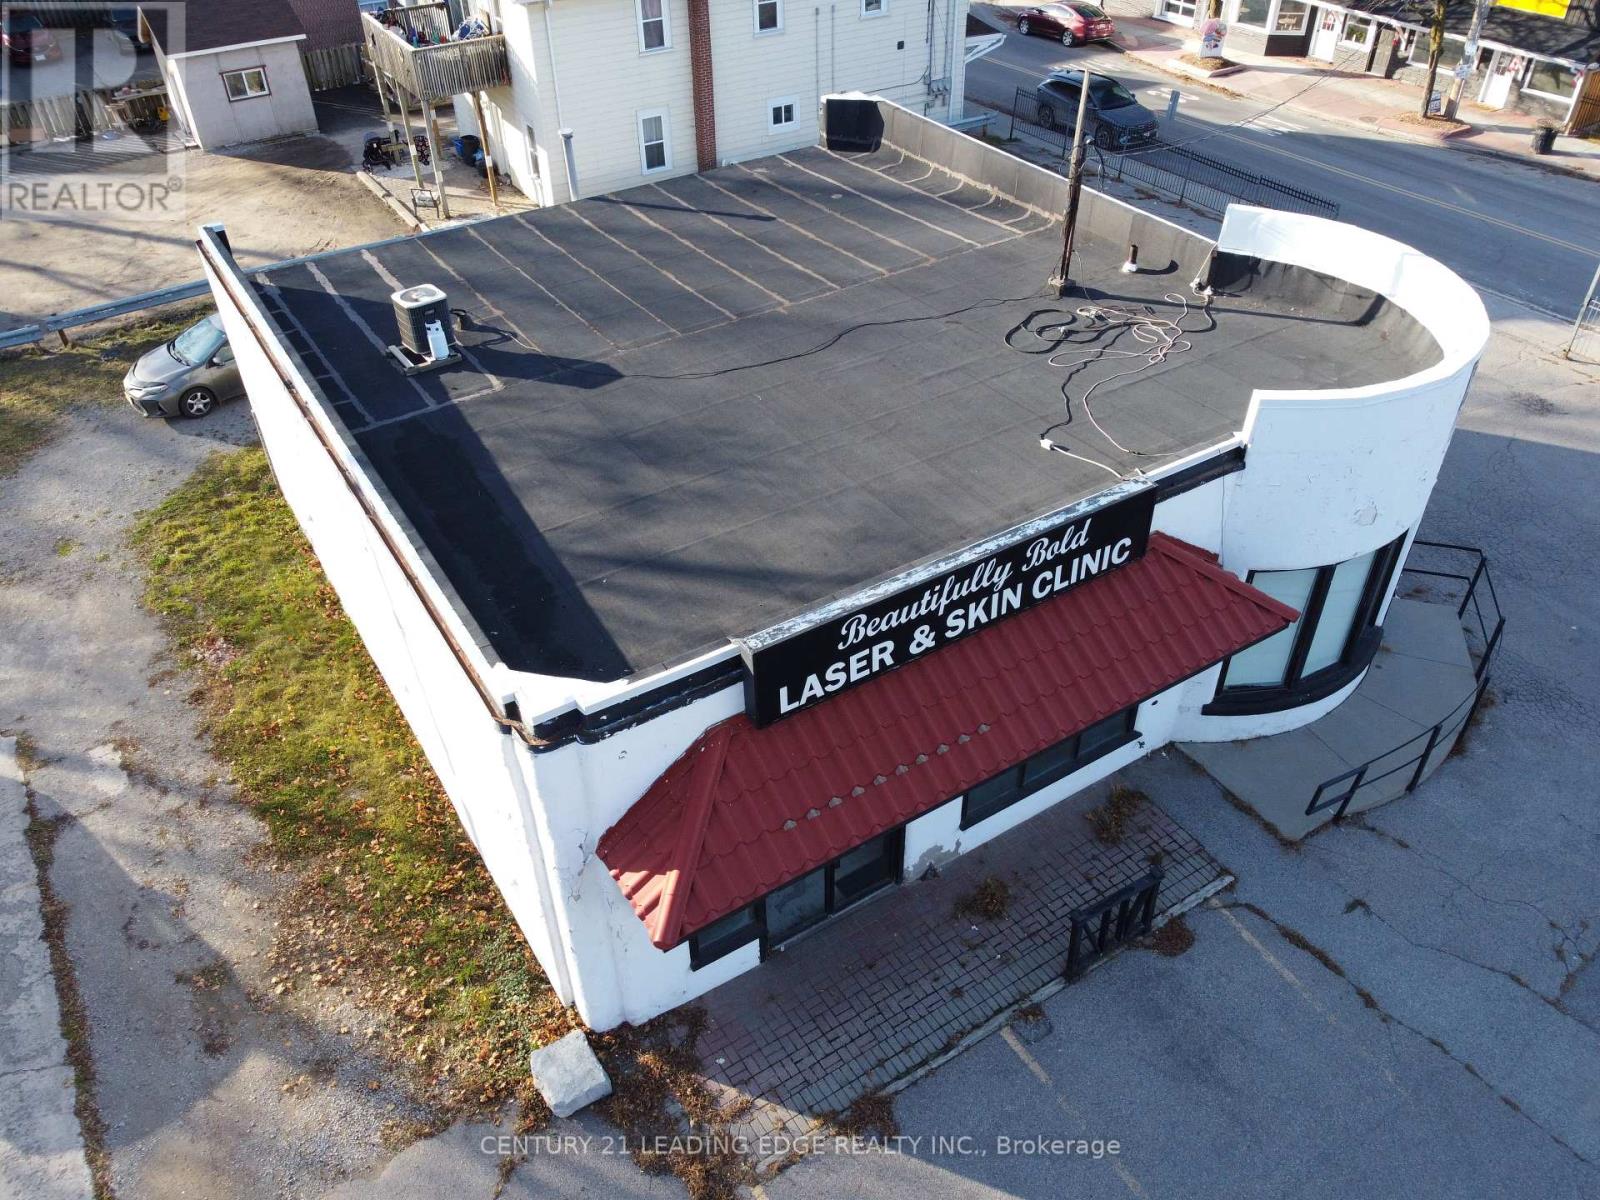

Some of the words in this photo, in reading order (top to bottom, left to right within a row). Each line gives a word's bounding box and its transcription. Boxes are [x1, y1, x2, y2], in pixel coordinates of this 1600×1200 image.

[779, 640, 895, 715] LASER
[908, 624, 936, 655] &
[944, 583, 1023, 639] SKIN
[1032, 537, 1132, 600] CLINIC
[837, 557, 1013, 650] Beautifully
[1022, 518, 1092, 572] Bold
